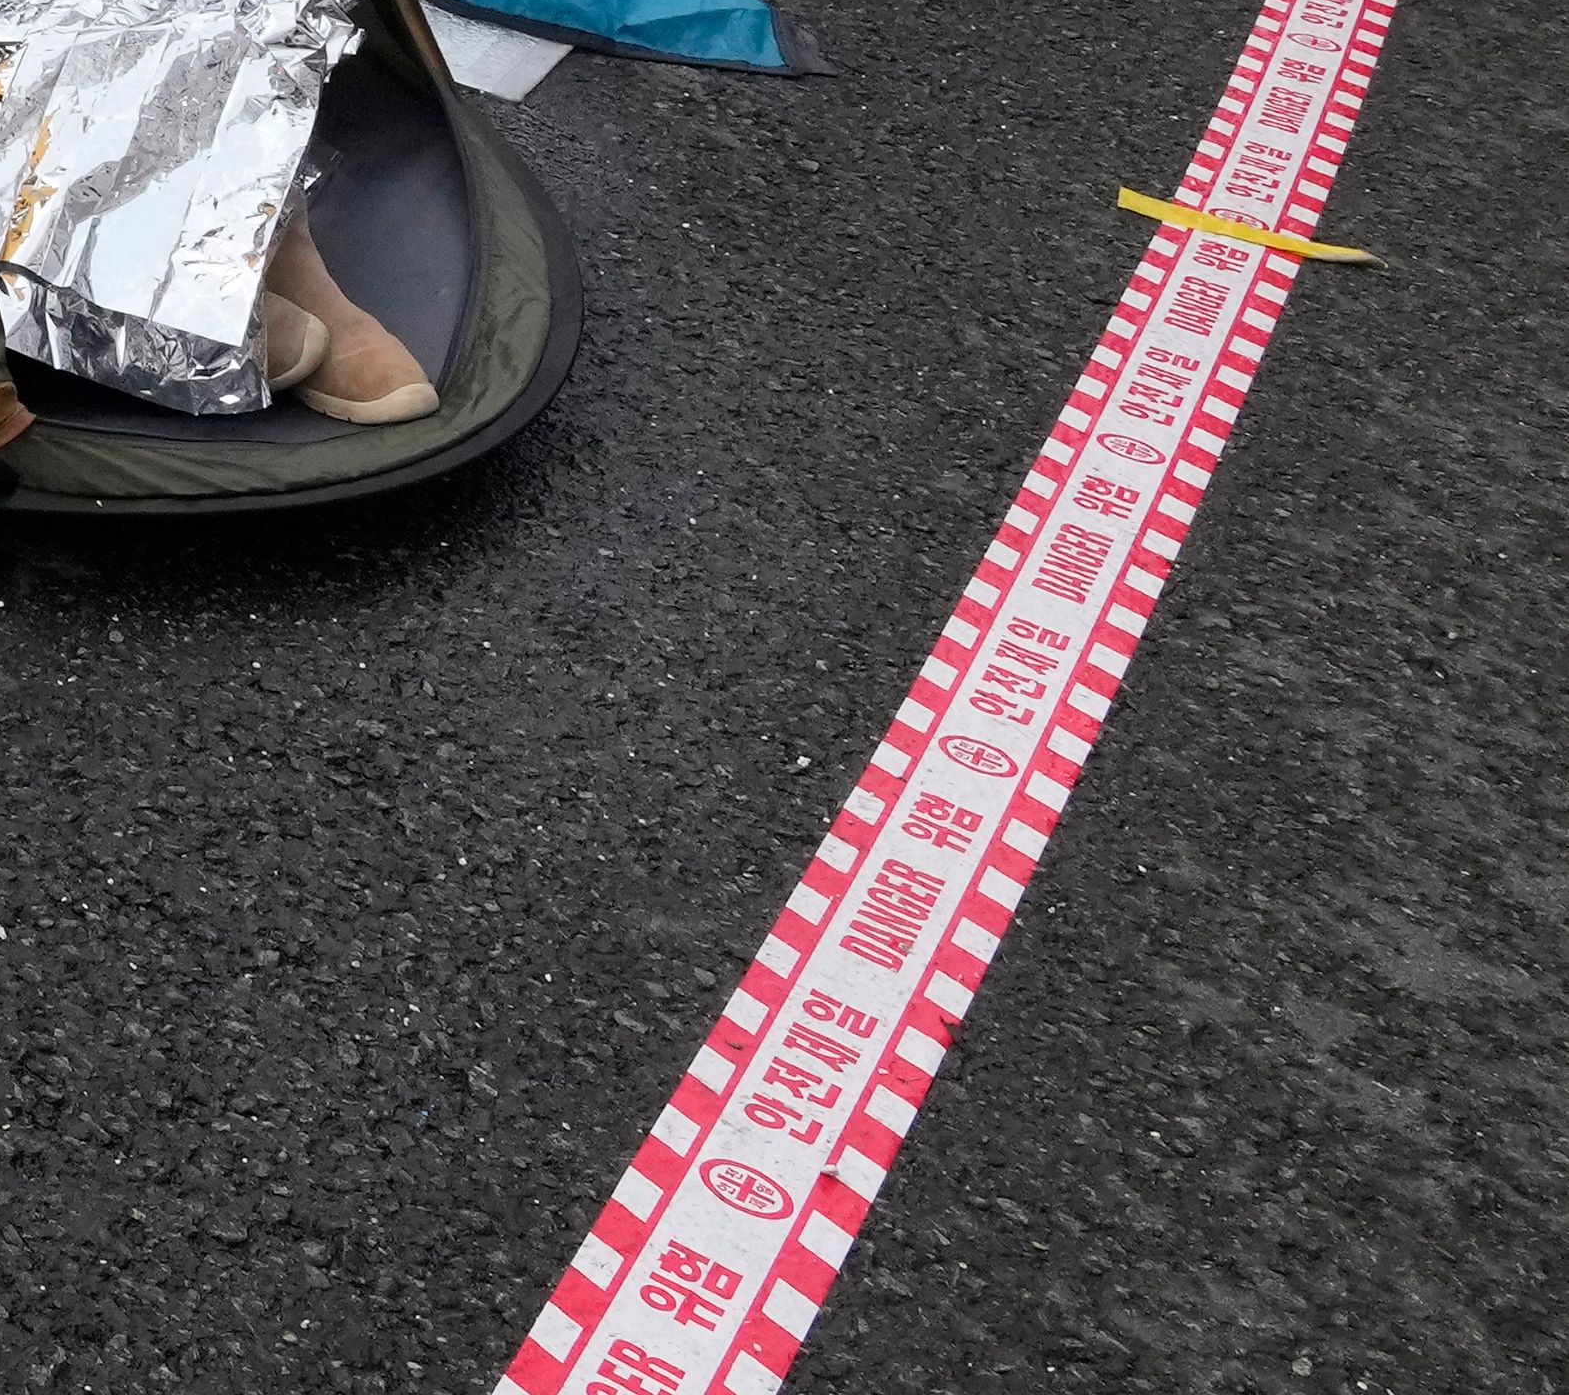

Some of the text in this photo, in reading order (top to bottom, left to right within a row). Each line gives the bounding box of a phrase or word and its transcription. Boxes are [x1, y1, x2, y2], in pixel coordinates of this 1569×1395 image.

[1277, 57, 1328, 86] 위험
[1257, 86, 1314, 135] DANGER
[1225, 141, 1293, 205] 안전제일
[1191, 240, 1251, 274] 위험
[1163, 275, 1227, 338] DANGER
[1119, 346, 1201, 427] 안전제일
[1072, 475, 1141, 521] 위험
[1030, 523, 1116, 605] DANGER
[969, 616, 1073, 727] 안전제일
[899, 790, 982, 854] 위험
[837, 857, 947, 974] DANGER
[743, 988, 879, 1145] 안전제일
[639, 1238, 745, 1332] 위험
